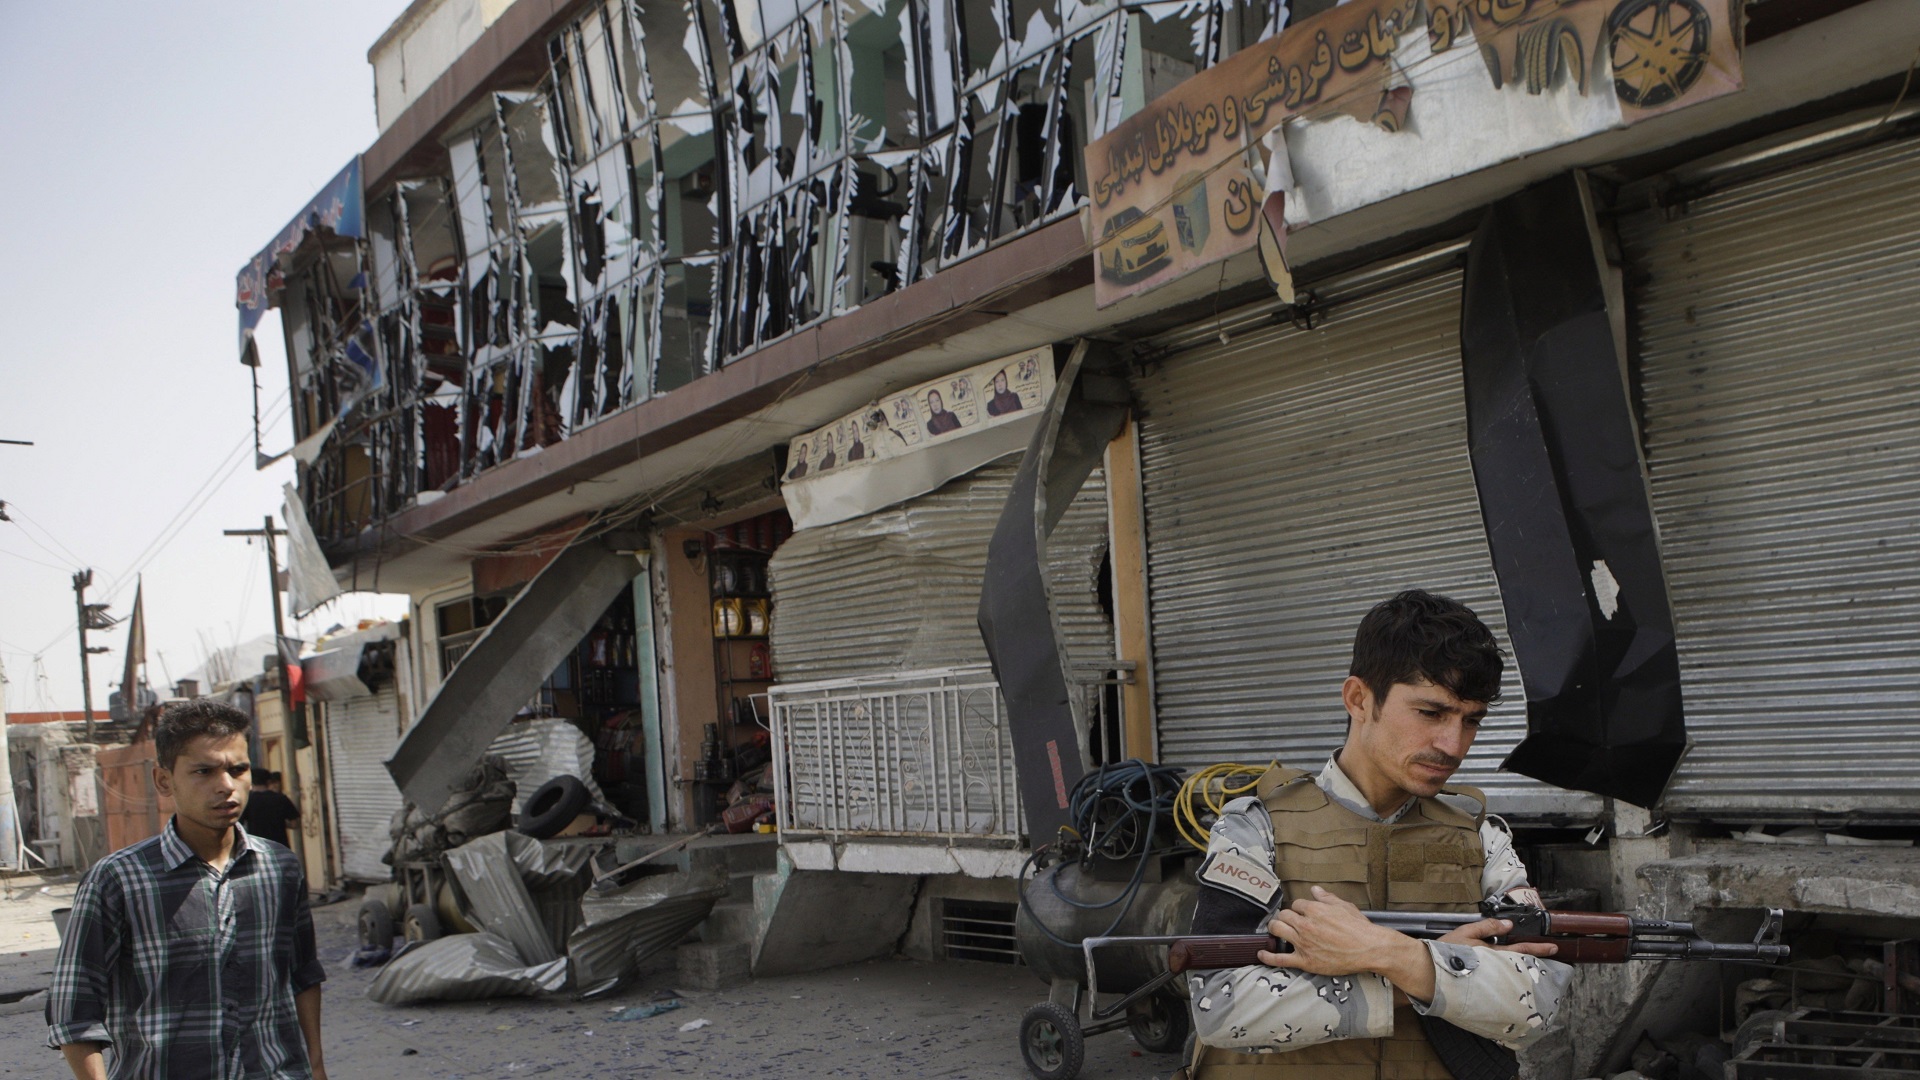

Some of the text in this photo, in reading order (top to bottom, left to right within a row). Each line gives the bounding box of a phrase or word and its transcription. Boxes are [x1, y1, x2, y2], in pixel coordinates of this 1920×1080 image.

[1242, 30, 1333, 126] فروشی
[1223, 95, 1239, 140] و
[1214, 863, 1271, 889] ANCOP
